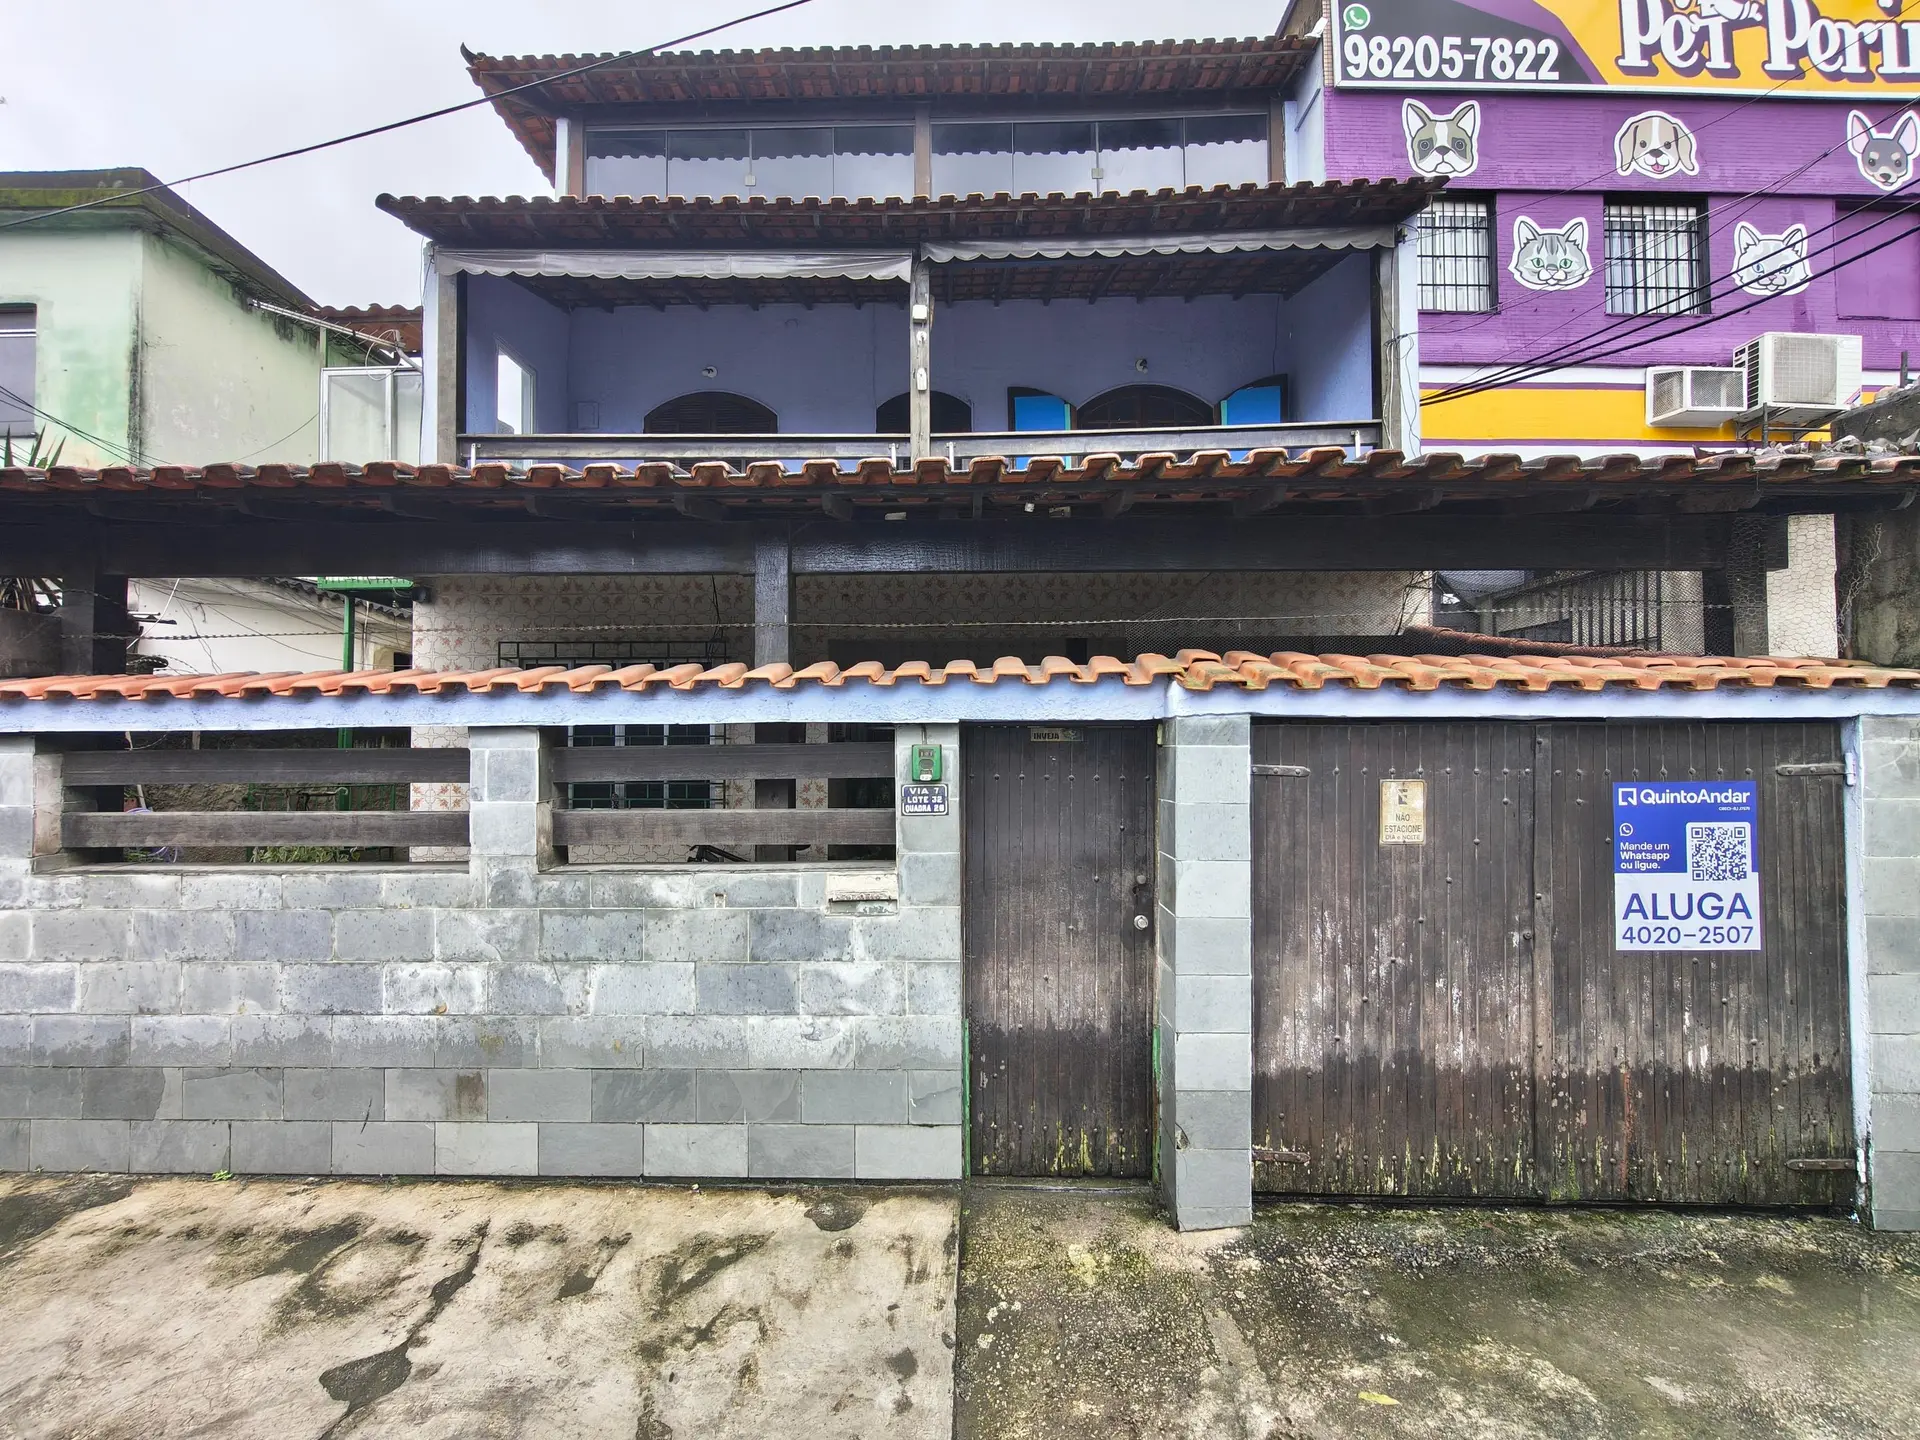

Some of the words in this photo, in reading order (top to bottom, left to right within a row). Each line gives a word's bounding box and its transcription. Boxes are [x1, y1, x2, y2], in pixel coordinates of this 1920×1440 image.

[1343, 33, 1560, 81] 98205-7822
[1033, 732, 1060, 740] INVEJA
[909, 787, 929, 795] VIA
[933, 787, 940, 795] 7
[907, 796, 929, 804] LOTE
[931, 796, 943, 804] 32
[1640, 788, 1750, 805] QuintoAndar
[905, 804, 932, 813] QUADRA
[1384, 824, 1422, 833] ESTACIONE
[1620, 841, 1653, 850] Mande
[1620, 851, 1670, 861] Whatsapp
[1634, 860, 1661, 871] ligue.
[1622, 892, 1753, 920] ALUGA
[1622, 926, 1754, 944] 4020-2507
